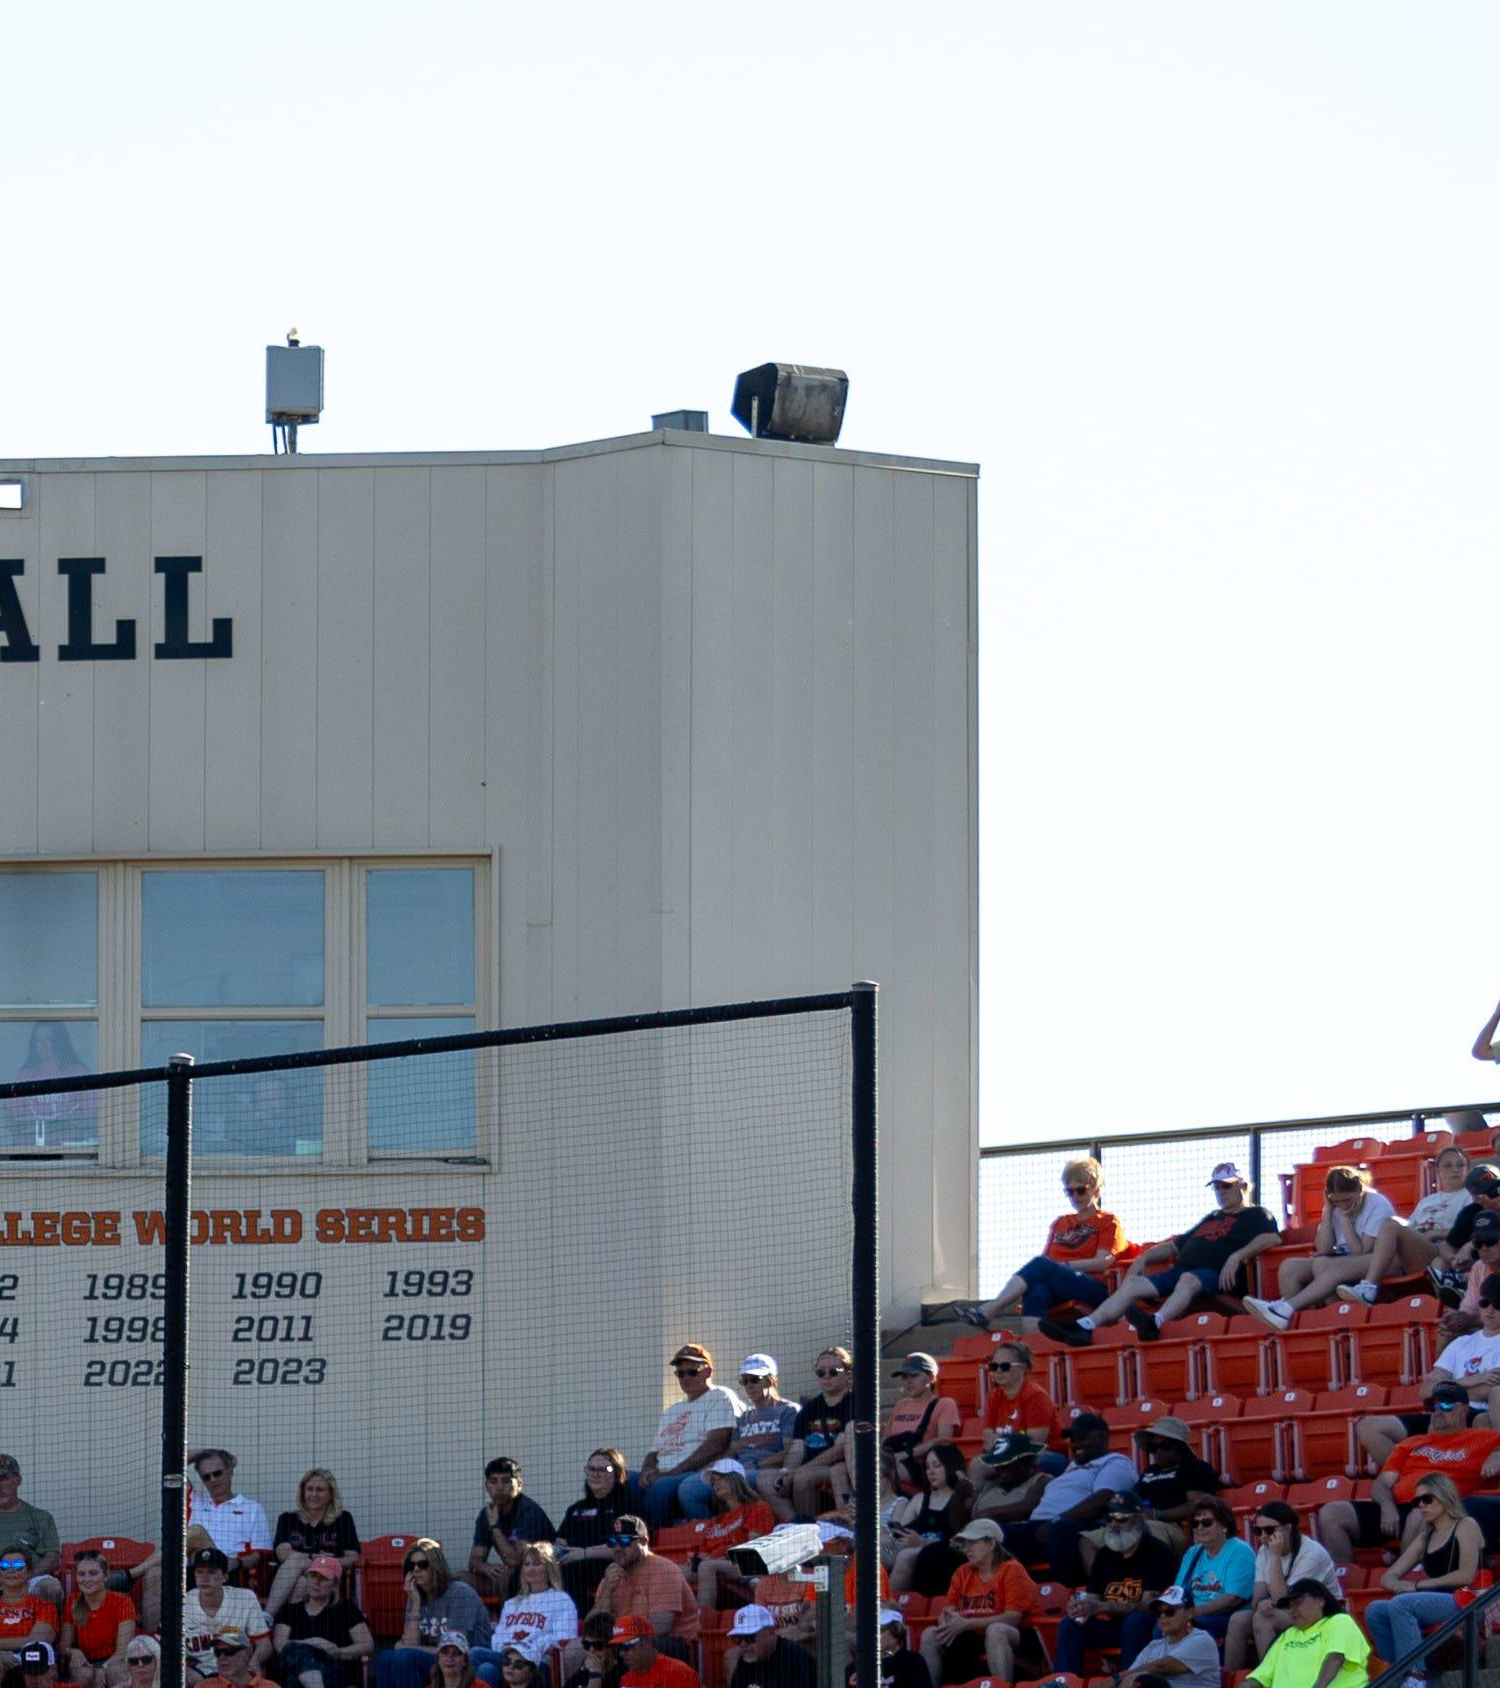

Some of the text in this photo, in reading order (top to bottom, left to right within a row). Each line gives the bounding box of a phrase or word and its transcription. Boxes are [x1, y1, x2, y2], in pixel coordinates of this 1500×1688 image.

[136, 1211, 300, 1244] WORLD
[318, 1208, 484, 1242] SERIES
[83, 1273, 166, 1300] 1989
[232, 1272, 322, 1299] 1990
[384, 1270, 473, 1297] 1993
[83, 1316, 165, 1343] 1998
[232, 1316, 312, 1342] 2011
[383, 1314, 471, 1340] 2019
[234, 1358, 326, 1385] 2023
